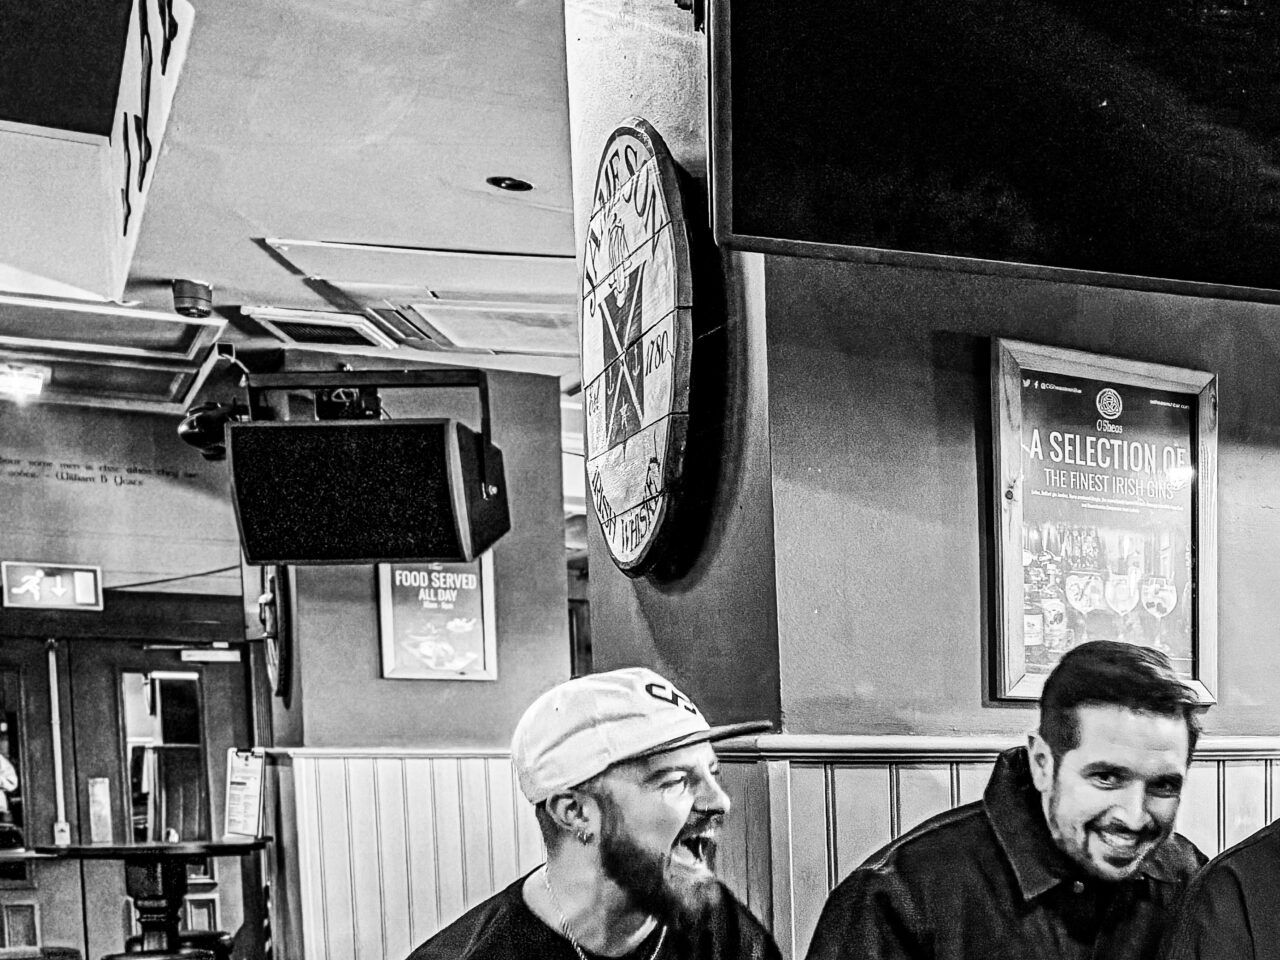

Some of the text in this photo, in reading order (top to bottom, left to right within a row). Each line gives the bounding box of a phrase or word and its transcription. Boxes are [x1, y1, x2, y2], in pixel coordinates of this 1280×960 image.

[585, 144, 664, 317] JAMESON
[1029, 428, 1186, 475] A SELECTION OF
[1043, 468, 1174, 500] THE FINEST IRISH GINS
[395, 570, 477, 589] FOOD SERVED
[418, 588, 458, 602] ALL DAY
